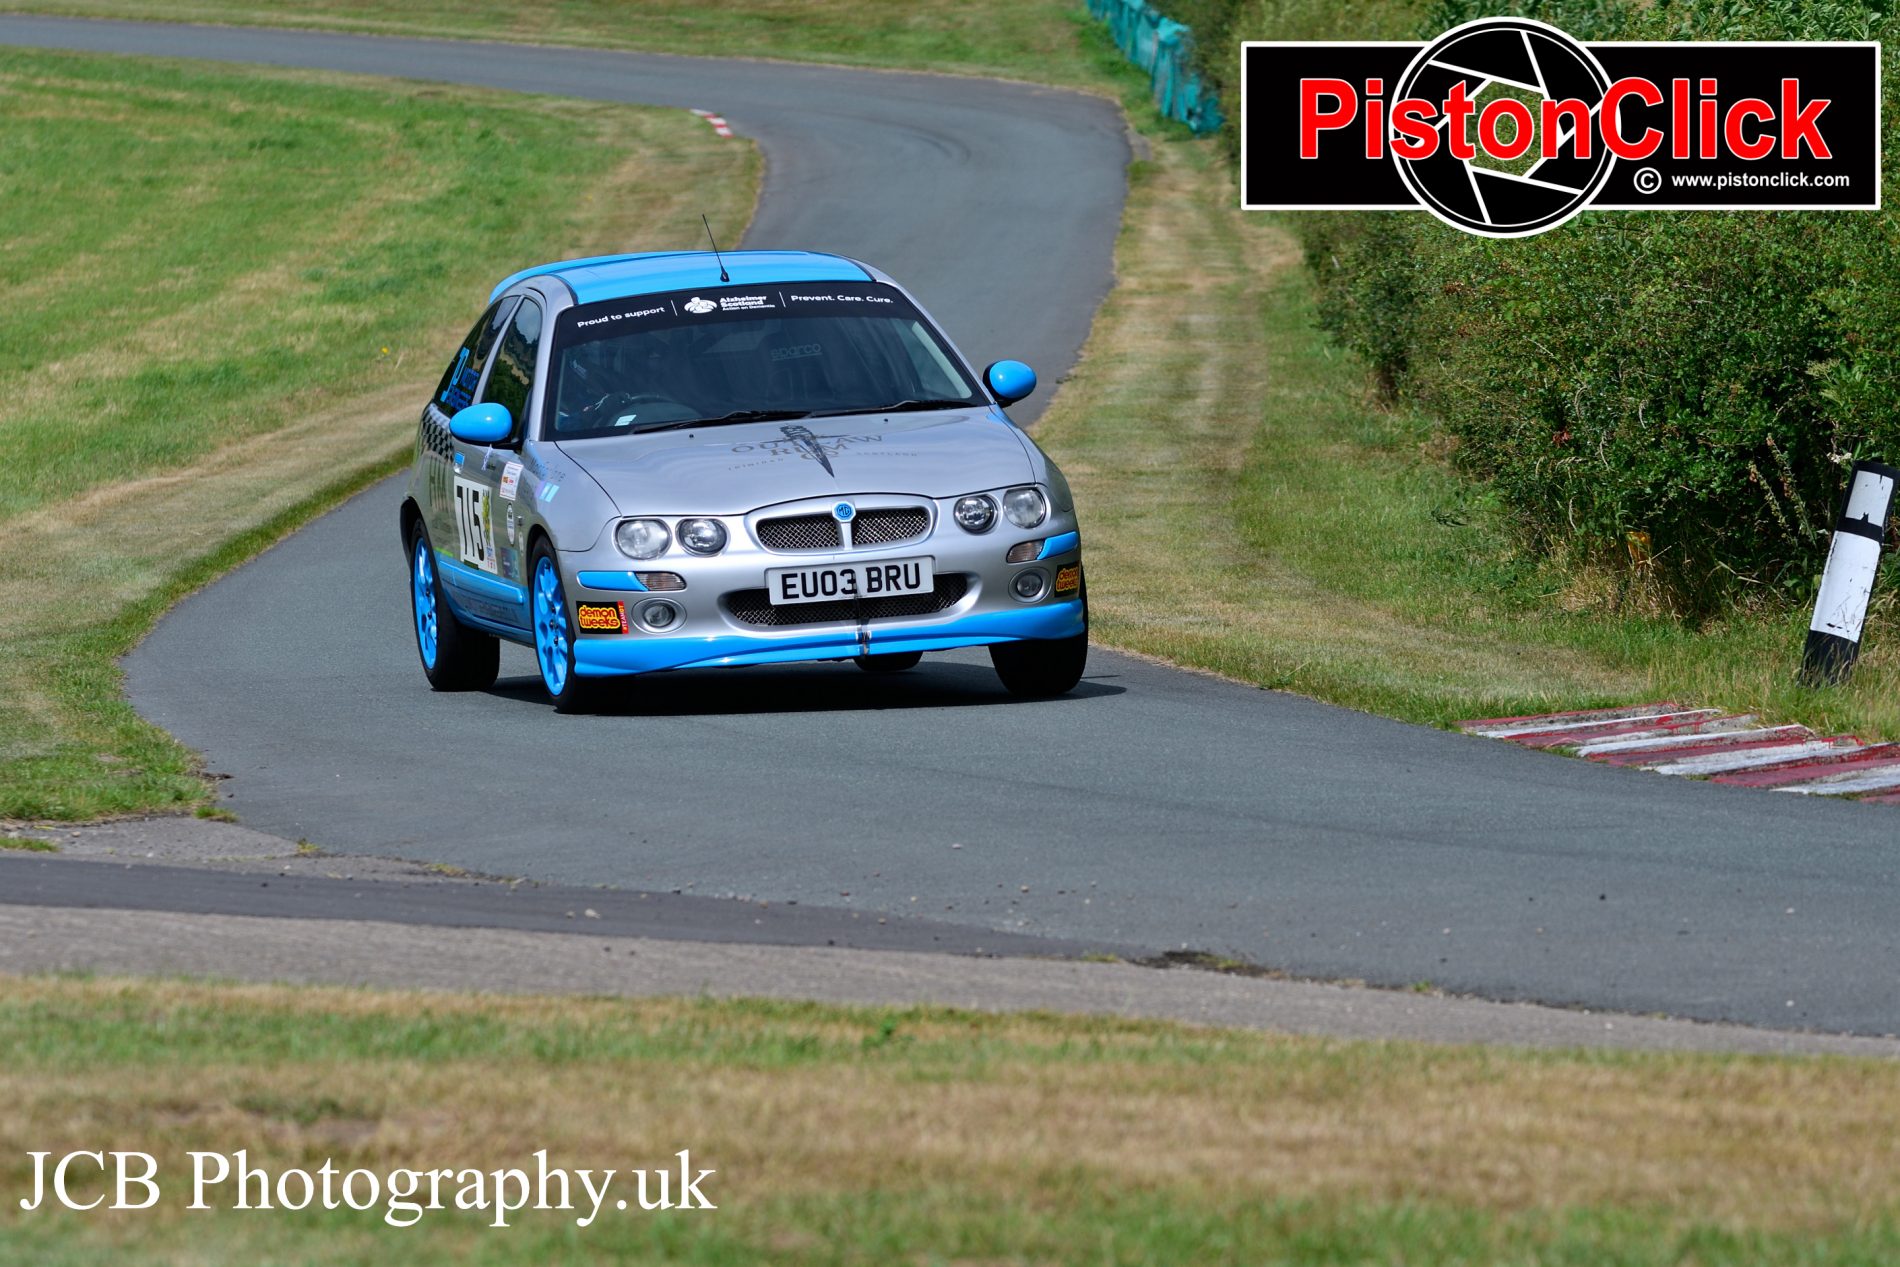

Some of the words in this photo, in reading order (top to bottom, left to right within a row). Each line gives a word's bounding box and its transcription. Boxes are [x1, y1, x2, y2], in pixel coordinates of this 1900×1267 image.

[720, 295, 767, 303] Alzheimer
[720, 299, 764, 307] Scotland
[790, 294, 835, 302] Prevent.
[837, 294, 864, 302] Care.
[577, 315, 609, 328] Proud
[624, 306, 665, 318] support
[456, 485, 485, 561] 715
[781, 569, 858, 600] EU03
[866, 562, 921, 593] BRU
[579, 605, 617, 618] demon
[579, 617, 620, 628] tweeks
